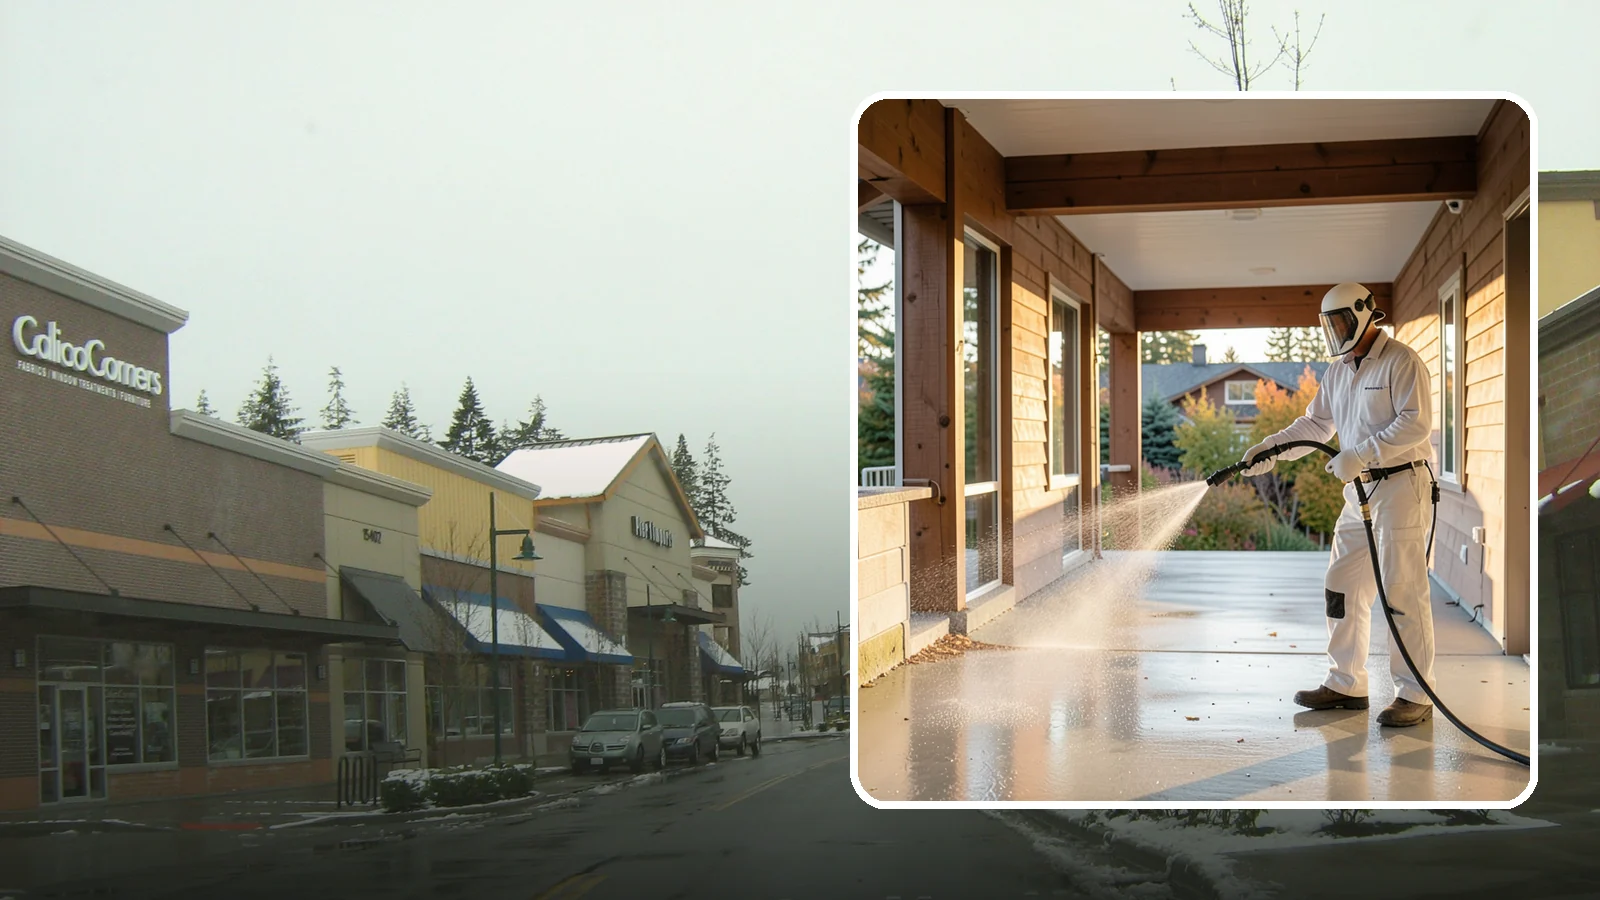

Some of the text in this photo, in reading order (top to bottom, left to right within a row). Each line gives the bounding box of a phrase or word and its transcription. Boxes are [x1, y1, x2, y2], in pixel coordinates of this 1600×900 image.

[17, 359, 47, 378] FABRICS
[51, 370, 78, 387] WINDOW
[79, 378, 117, 398] TREATMENTS
